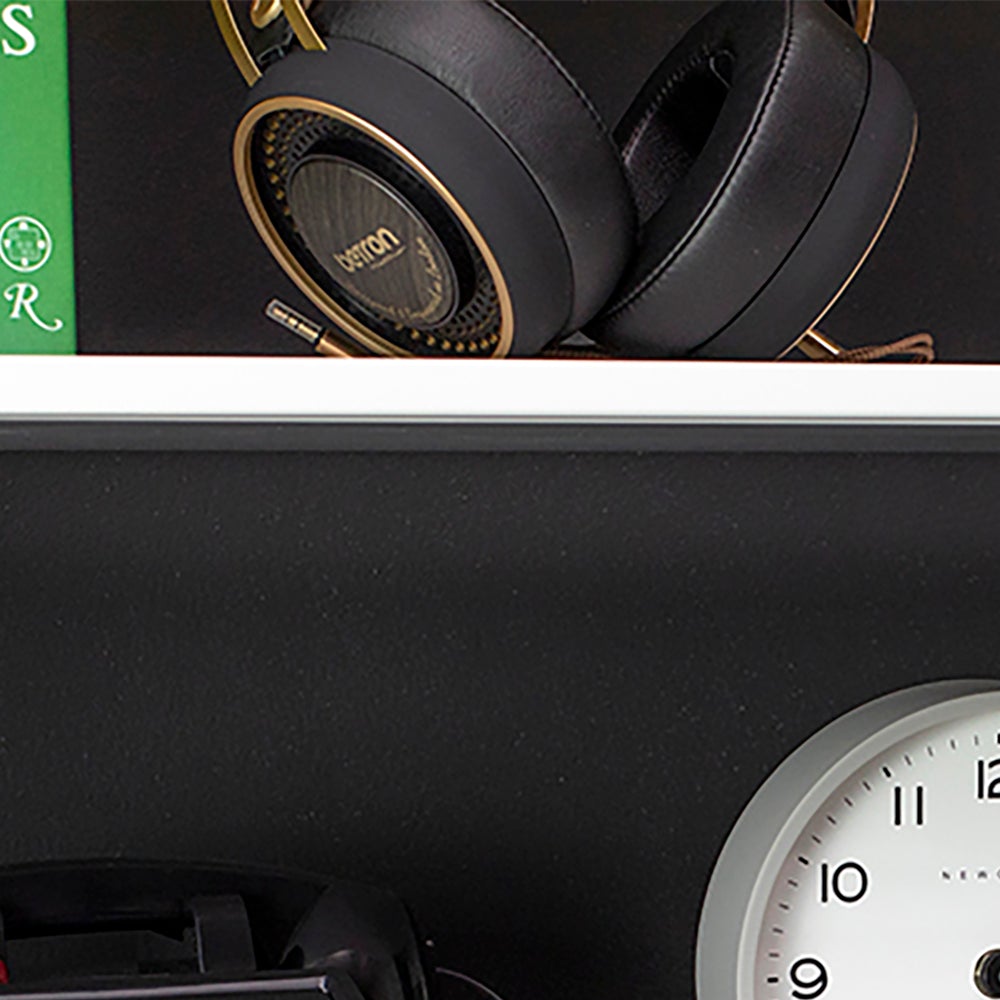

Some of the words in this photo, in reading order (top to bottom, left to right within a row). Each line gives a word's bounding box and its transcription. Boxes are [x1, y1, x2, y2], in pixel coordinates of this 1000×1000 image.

[893, 785, 924, 827] 11
[820, 861, 869, 904] 10
[788, 956, 829, 1000] 9
